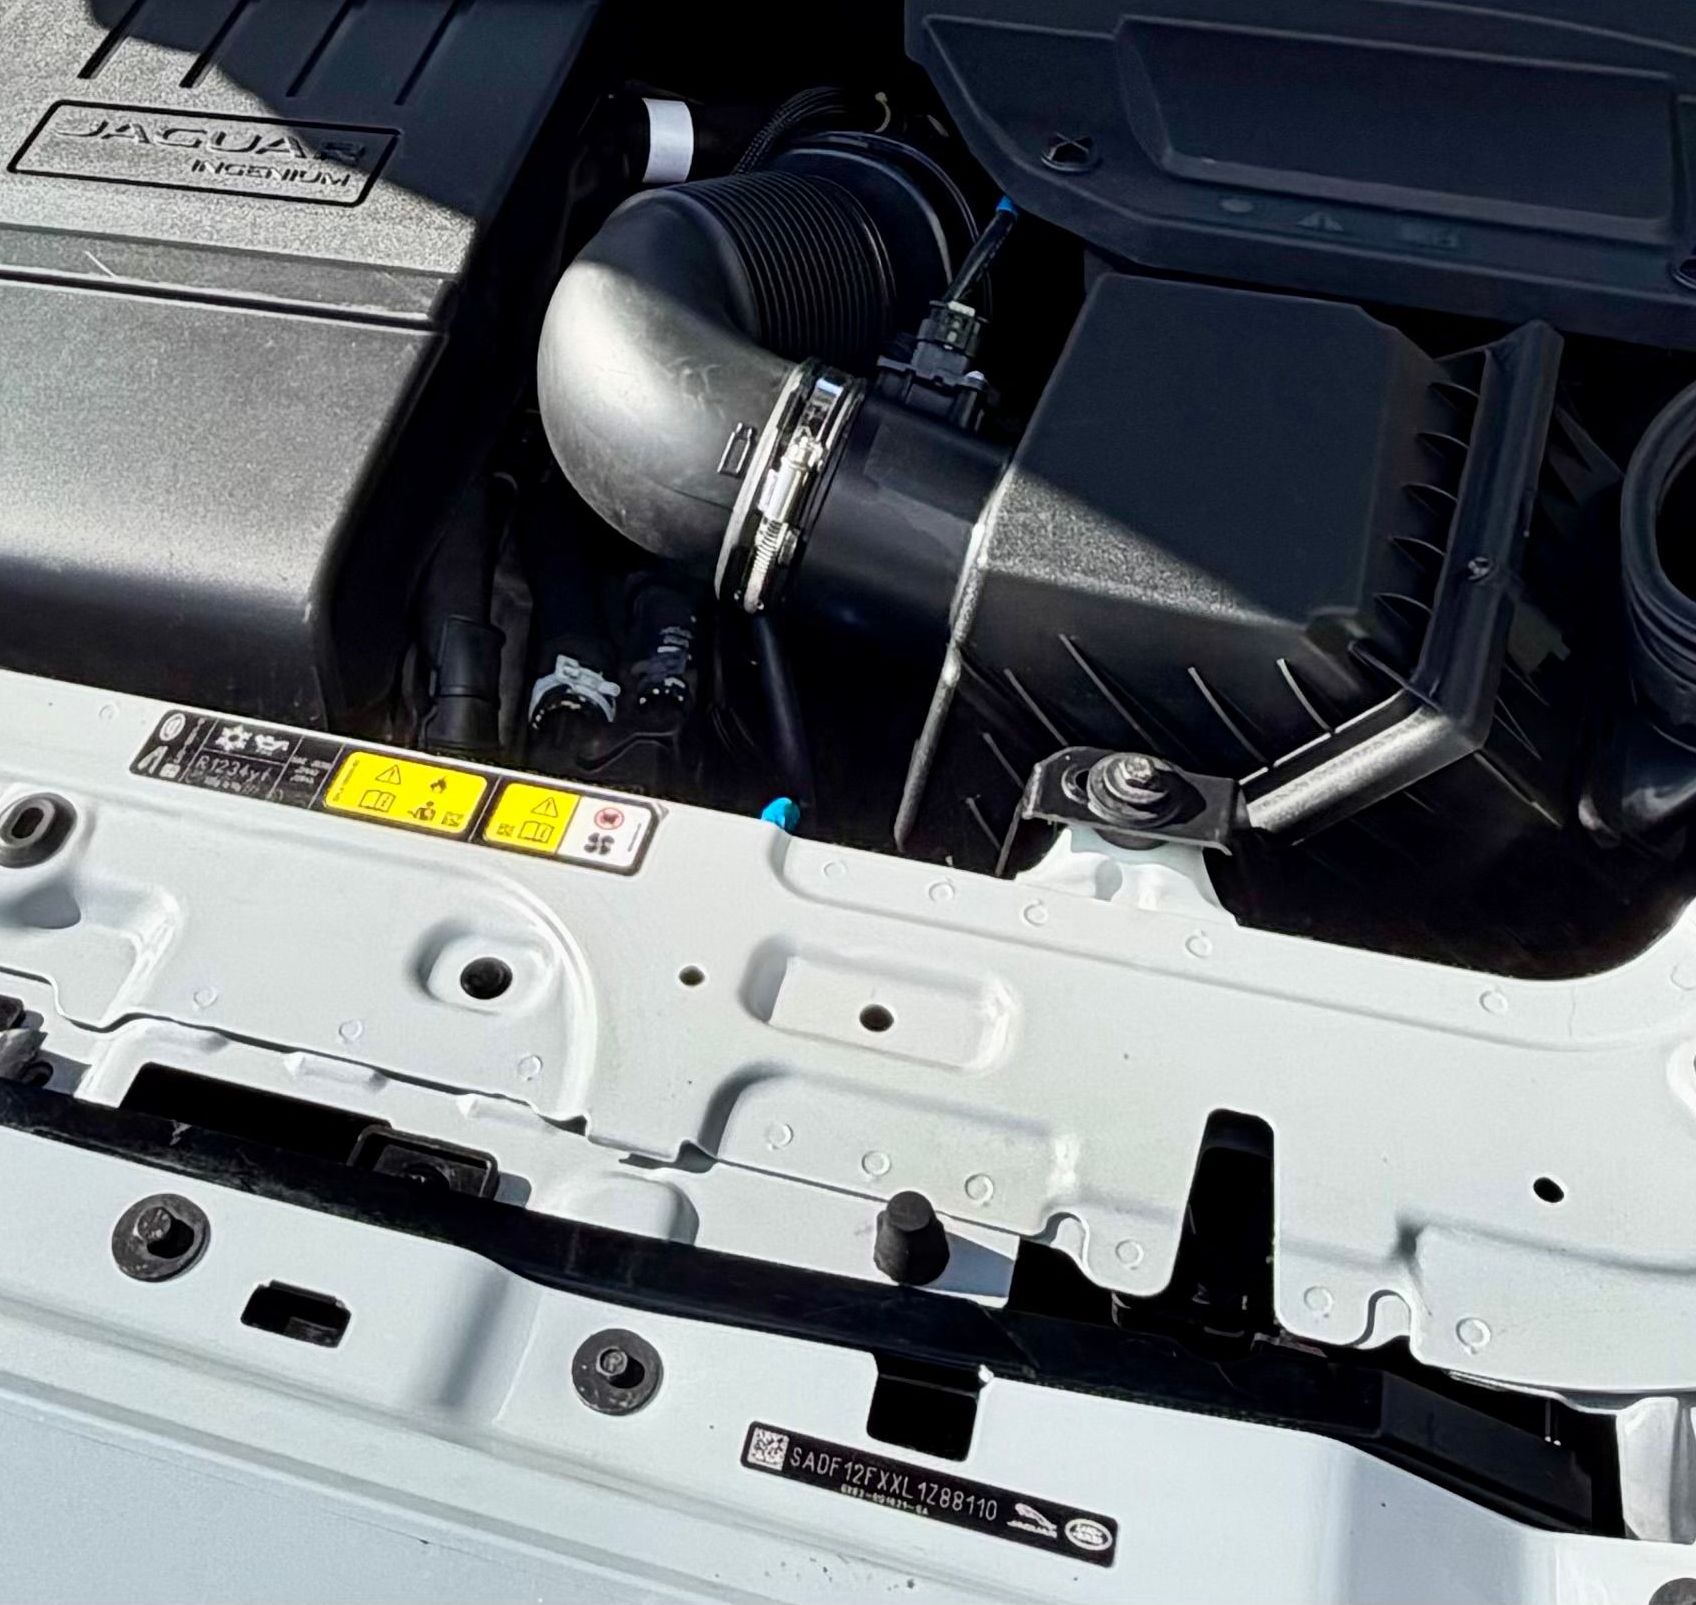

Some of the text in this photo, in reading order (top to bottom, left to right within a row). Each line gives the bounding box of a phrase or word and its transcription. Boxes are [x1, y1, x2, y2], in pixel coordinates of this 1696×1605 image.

[51, 119, 365, 161] JAGUAR
[190, 158, 352, 189] INGENIUM
[789, 1448, 998, 1521] SADF12FXXL1Z88110
